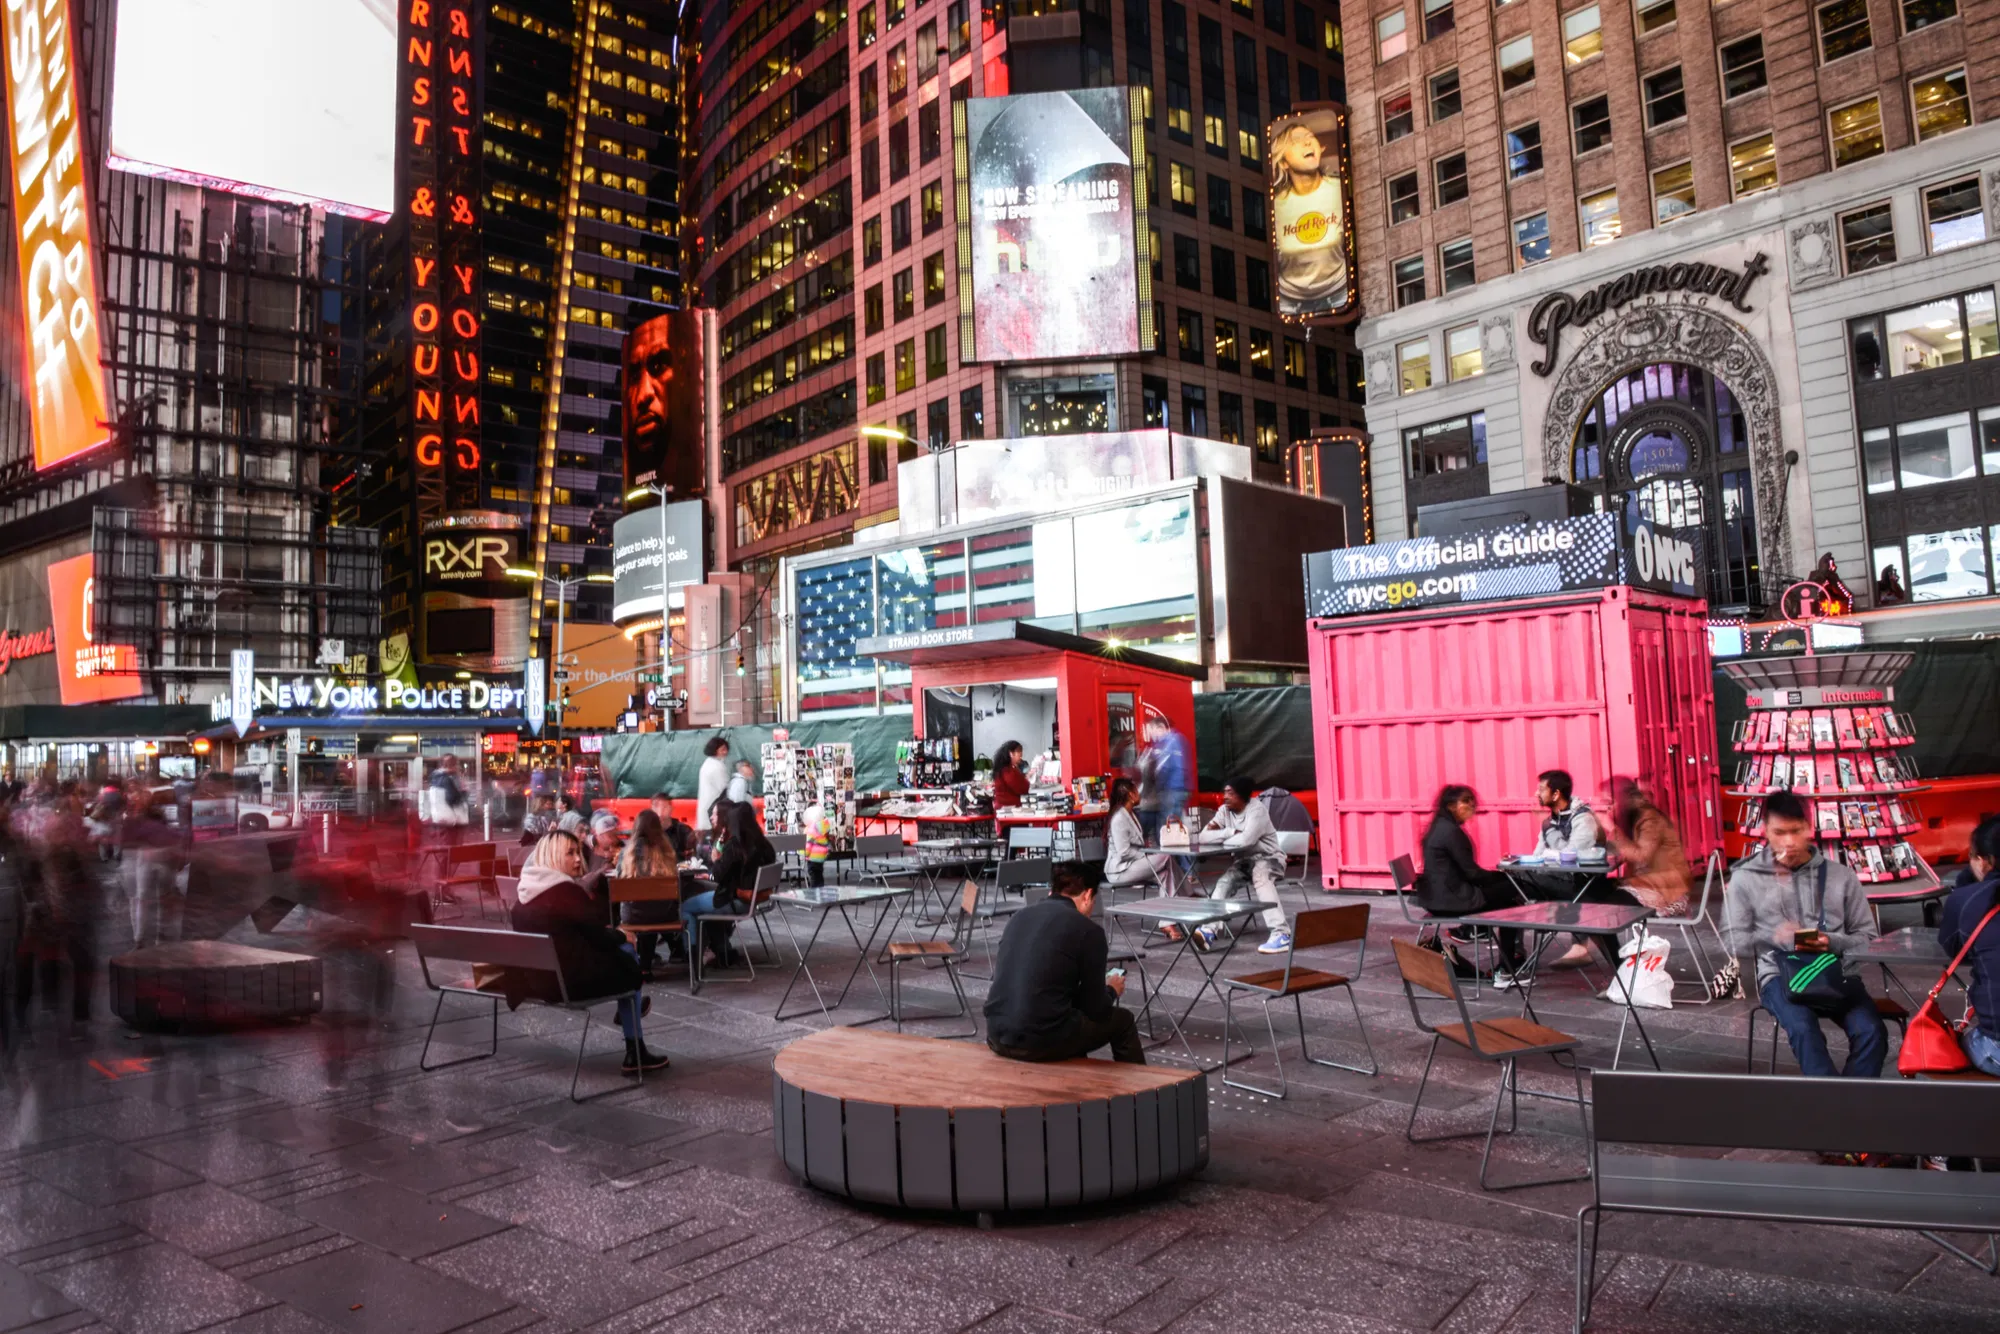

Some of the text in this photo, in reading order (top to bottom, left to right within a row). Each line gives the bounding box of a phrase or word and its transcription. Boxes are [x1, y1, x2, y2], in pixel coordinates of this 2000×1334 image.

[411, 187, 436, 217] &
[984, 186, 1019, 207] NOW
[1283, 212, 1337, 237] Hard Rock
[1527, 252, 1768, 377] Paramount
[413, 257, 442, 466] YOUNG
[425, 537, 510, 574] RXR
[642, 537, 658, 550] help
[1343, 526, 1575, 577] The Official Guide
[1653, 533, 1695, 586] NYC
[637, 554, 663, 568] savings
[1346, 572, 1478, 607] nycgo.com
[888, 629, 973, 649] STRAND BOOK STORE
[238, 652, 248, 717] NYPD
[532, 660, 540, 717] NYPD
[584, 668, 607, 682] the
[254, 676, 313, 709] NEW
[314, 677, 379, 709] YORK
[385, 678, 463, 709] POLICE
[469, 679, 525, 709] DEPT
